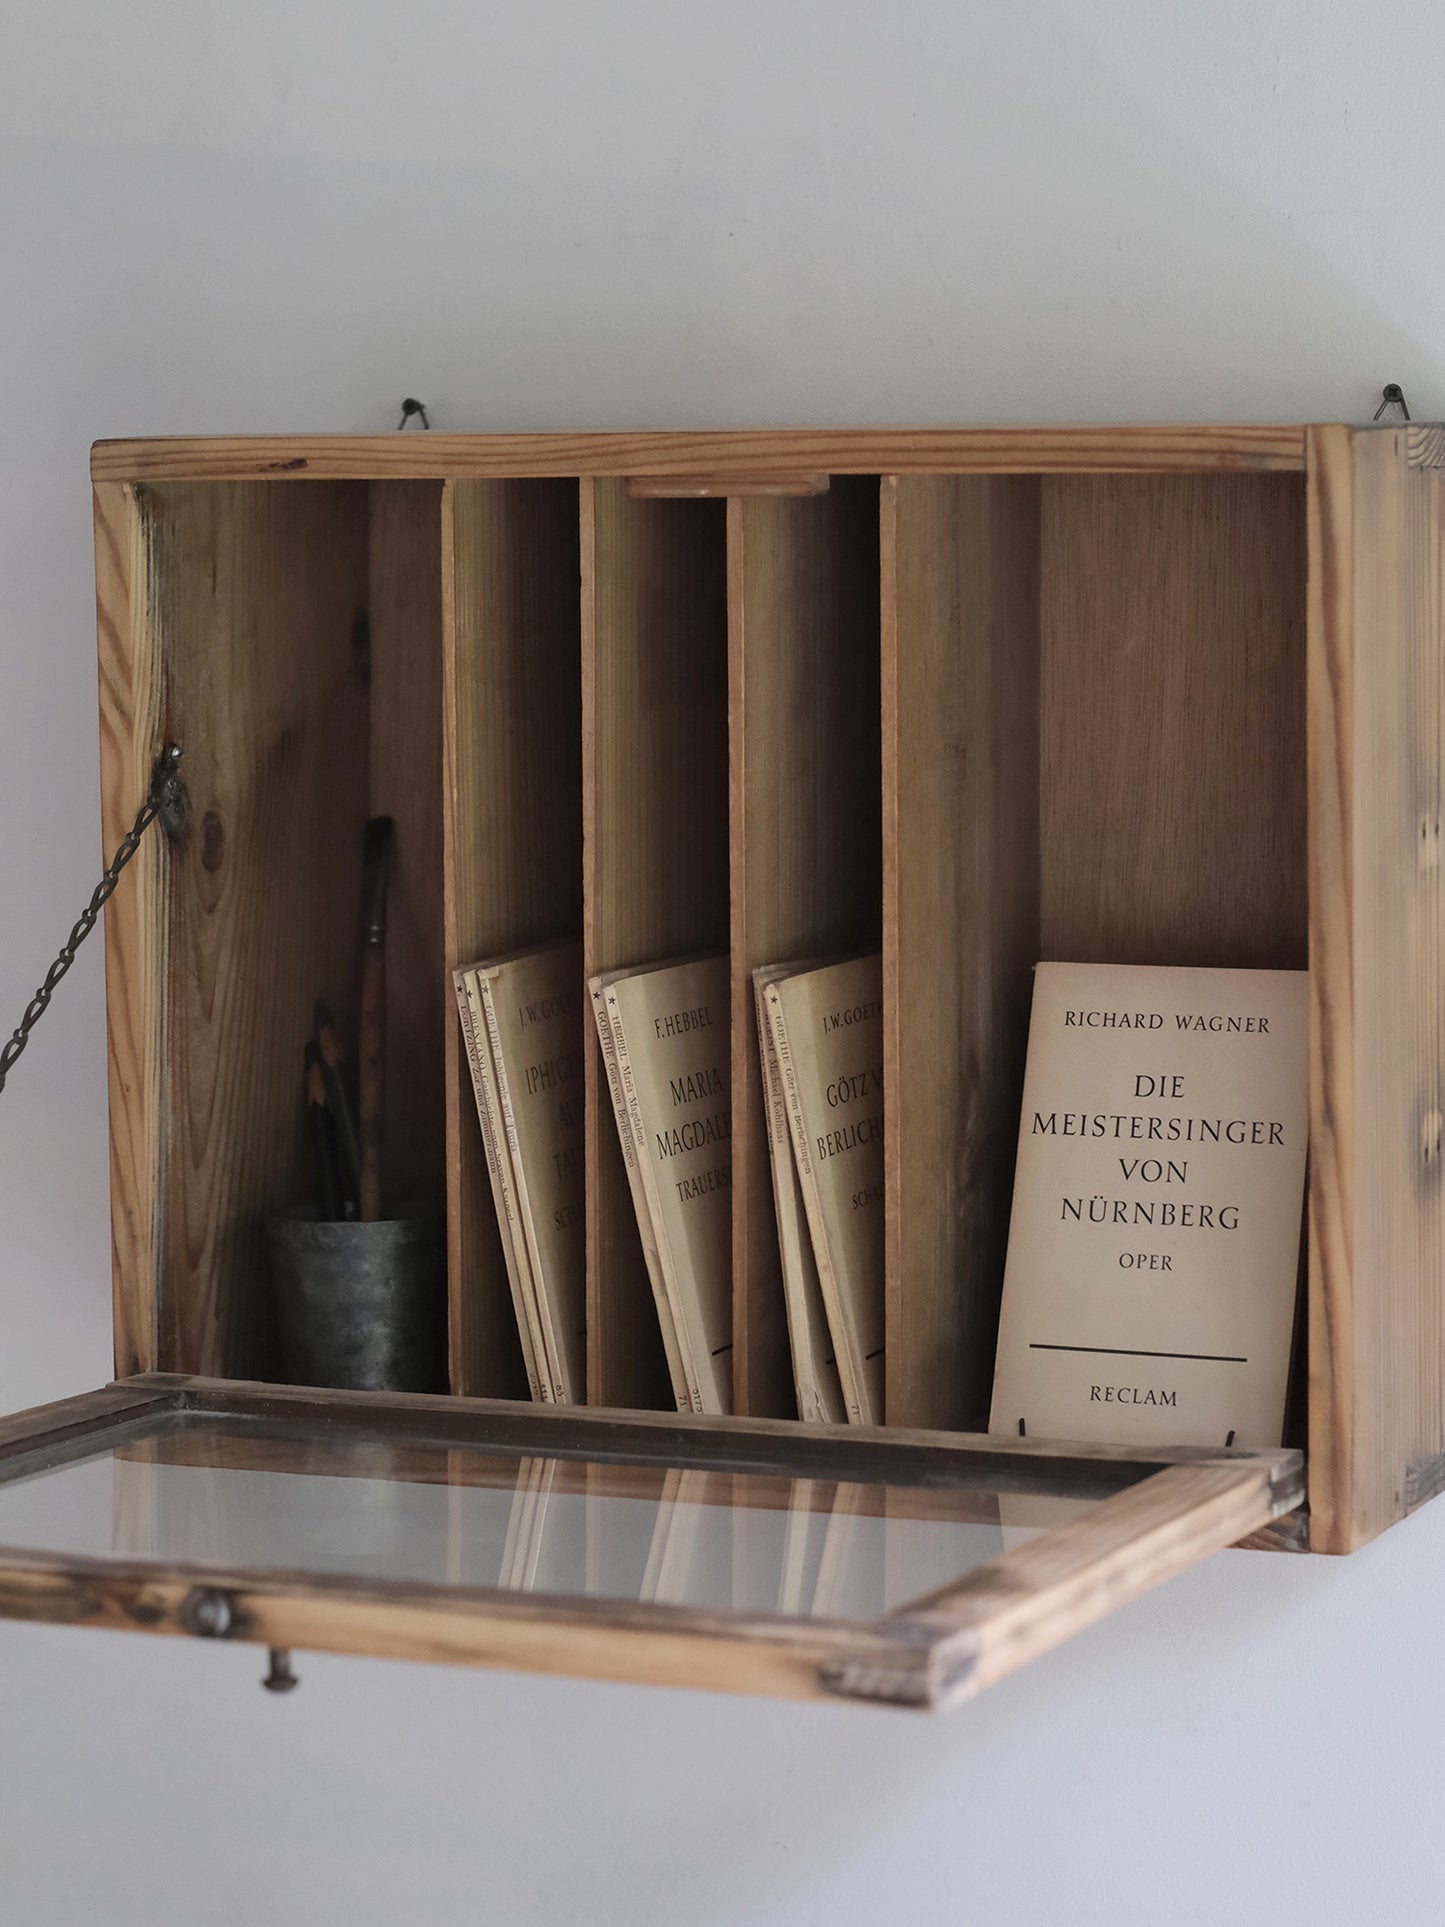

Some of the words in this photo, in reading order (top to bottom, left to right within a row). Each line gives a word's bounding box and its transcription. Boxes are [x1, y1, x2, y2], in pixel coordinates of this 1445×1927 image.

[485, 1005, 500, 1052] GOETHE
[1064, 1010, 1163, 1031] RICHARD
[1175, 1014, 1270, 1034] WAGNER
[597, 1011, 615, 1059] GOETHE
[613, 1088, 621, 1105] von
[618, 1108, 635, 1168] Berlichingen
[612, 1016, 628, 1061] HEBBEL
[621, 1065, 635, 1095] Maria
[629, 1097, 646, 1147] Magdalene
[669, 1068, 725, 1106] MARIA
[769, 1059, 781, 1098] Michael
[775, 1016, 790, 1064] GOETHE
[790, 1092, 799, 1111] von
[795, 1114, 812, 1175] Berlichingen
[826, 1072, 869, 1108] GÖTZ
[1133, 1075, 1185, 1099] DIE
[773, 1100, 785, 1144] Kohlhaas
[1031, 1112, 1285, 1146] MEISTERSINGER
[1118, 1158, 1188, 1184] VON
[1060, 1195, 1240, 1230] NÜRNBERG
[1118, 1252, 1173, 1271] OPER
[1090, 1385, 1178, 1407] RECLAM
